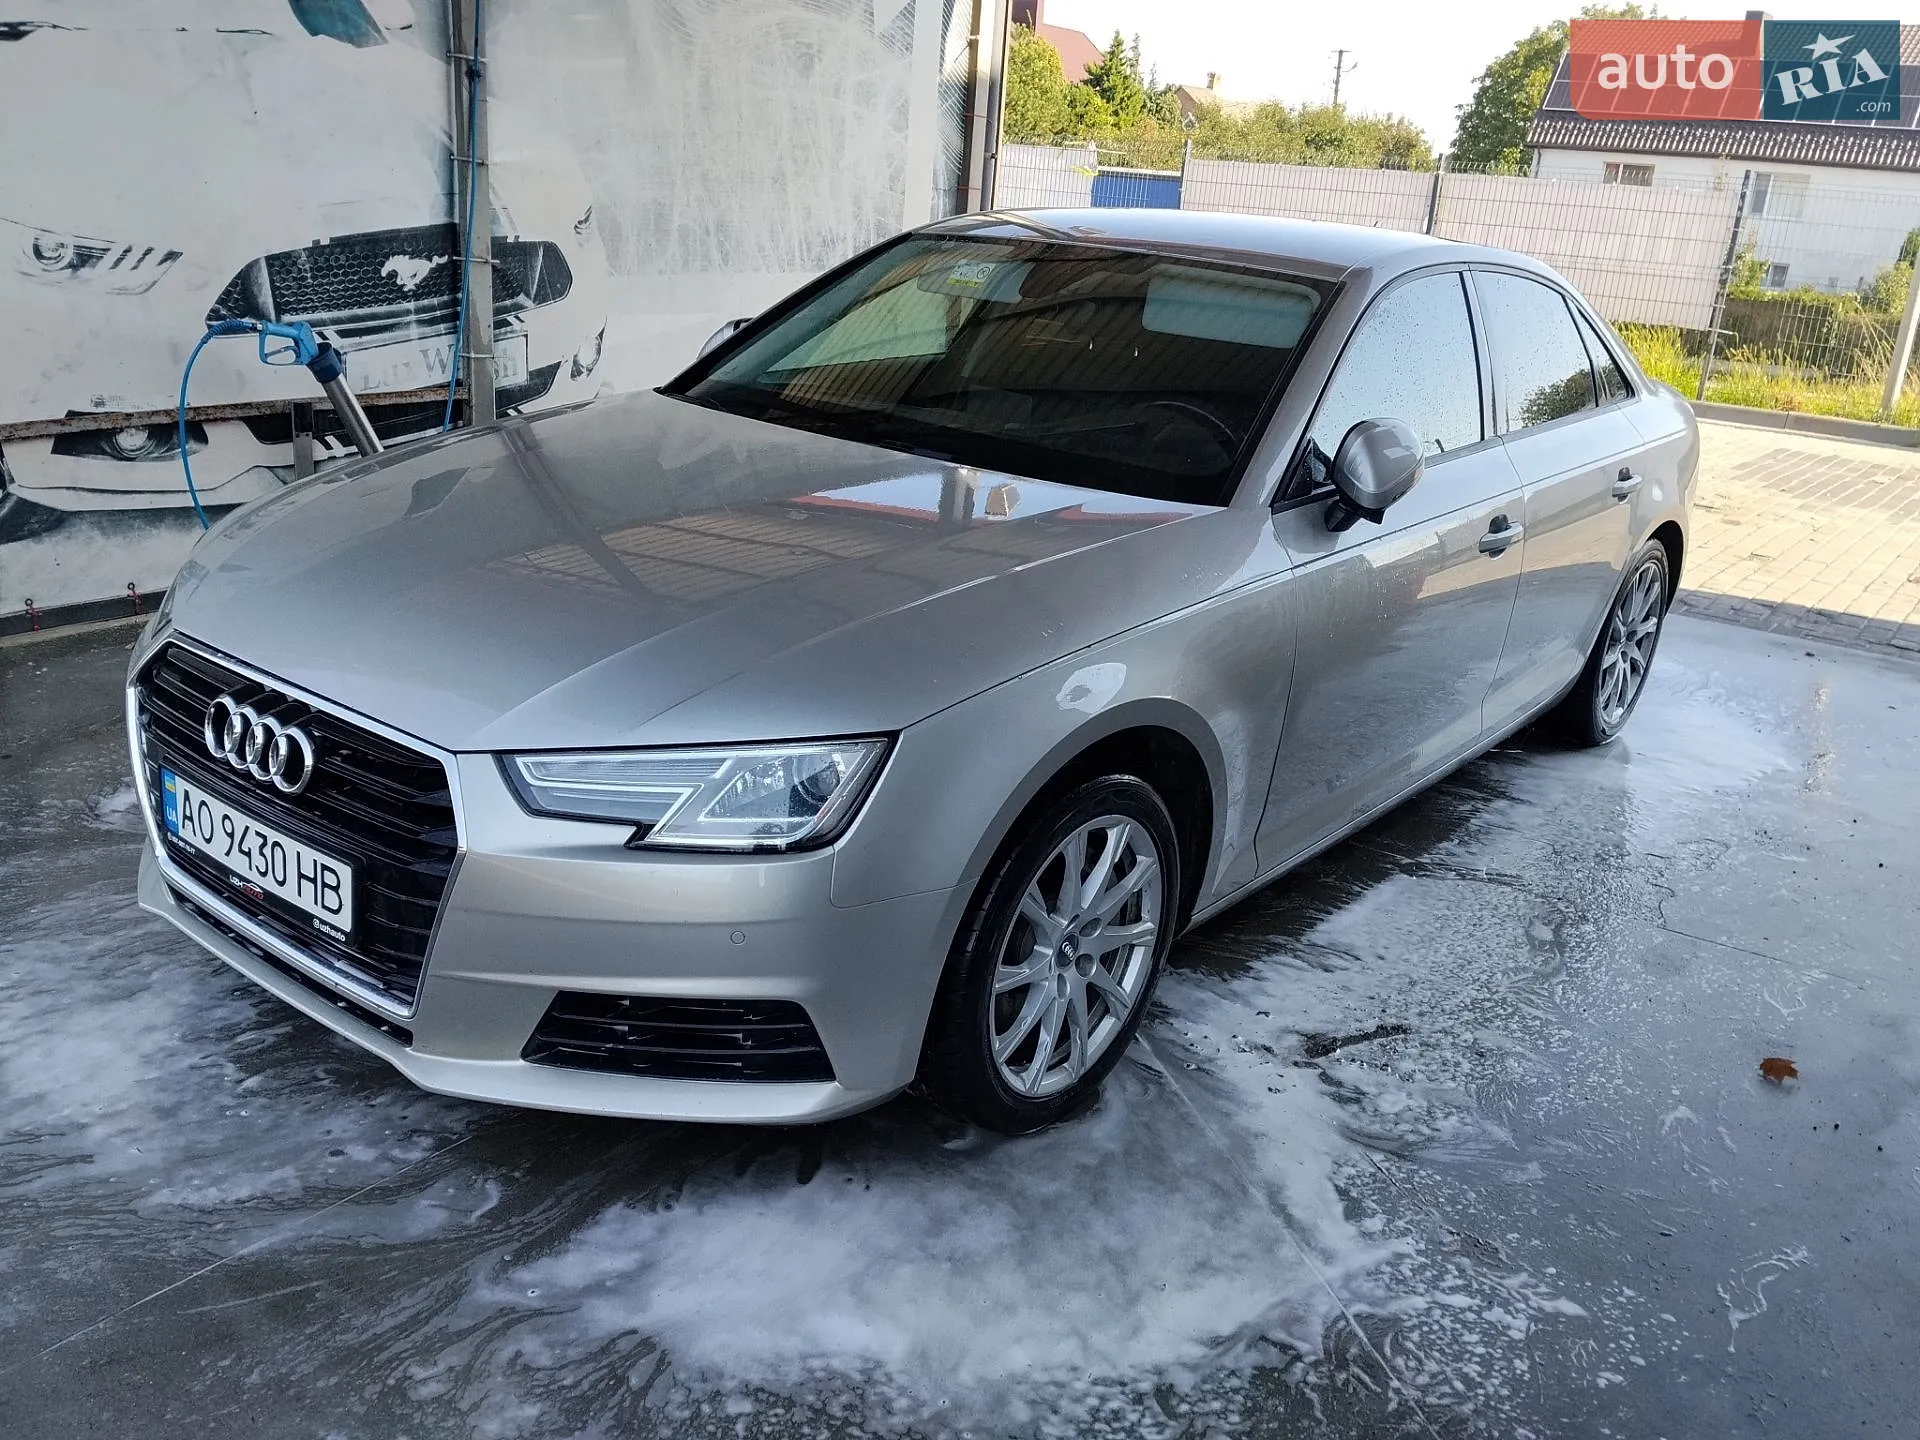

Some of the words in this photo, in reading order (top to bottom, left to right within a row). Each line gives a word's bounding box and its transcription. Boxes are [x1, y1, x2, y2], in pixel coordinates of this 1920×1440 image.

[166, 804, 178, 825] UA
[182, 788, 214, 845] AO
[221, 813, 287, 888] 9430
[296, 850, 343, 916] HB
